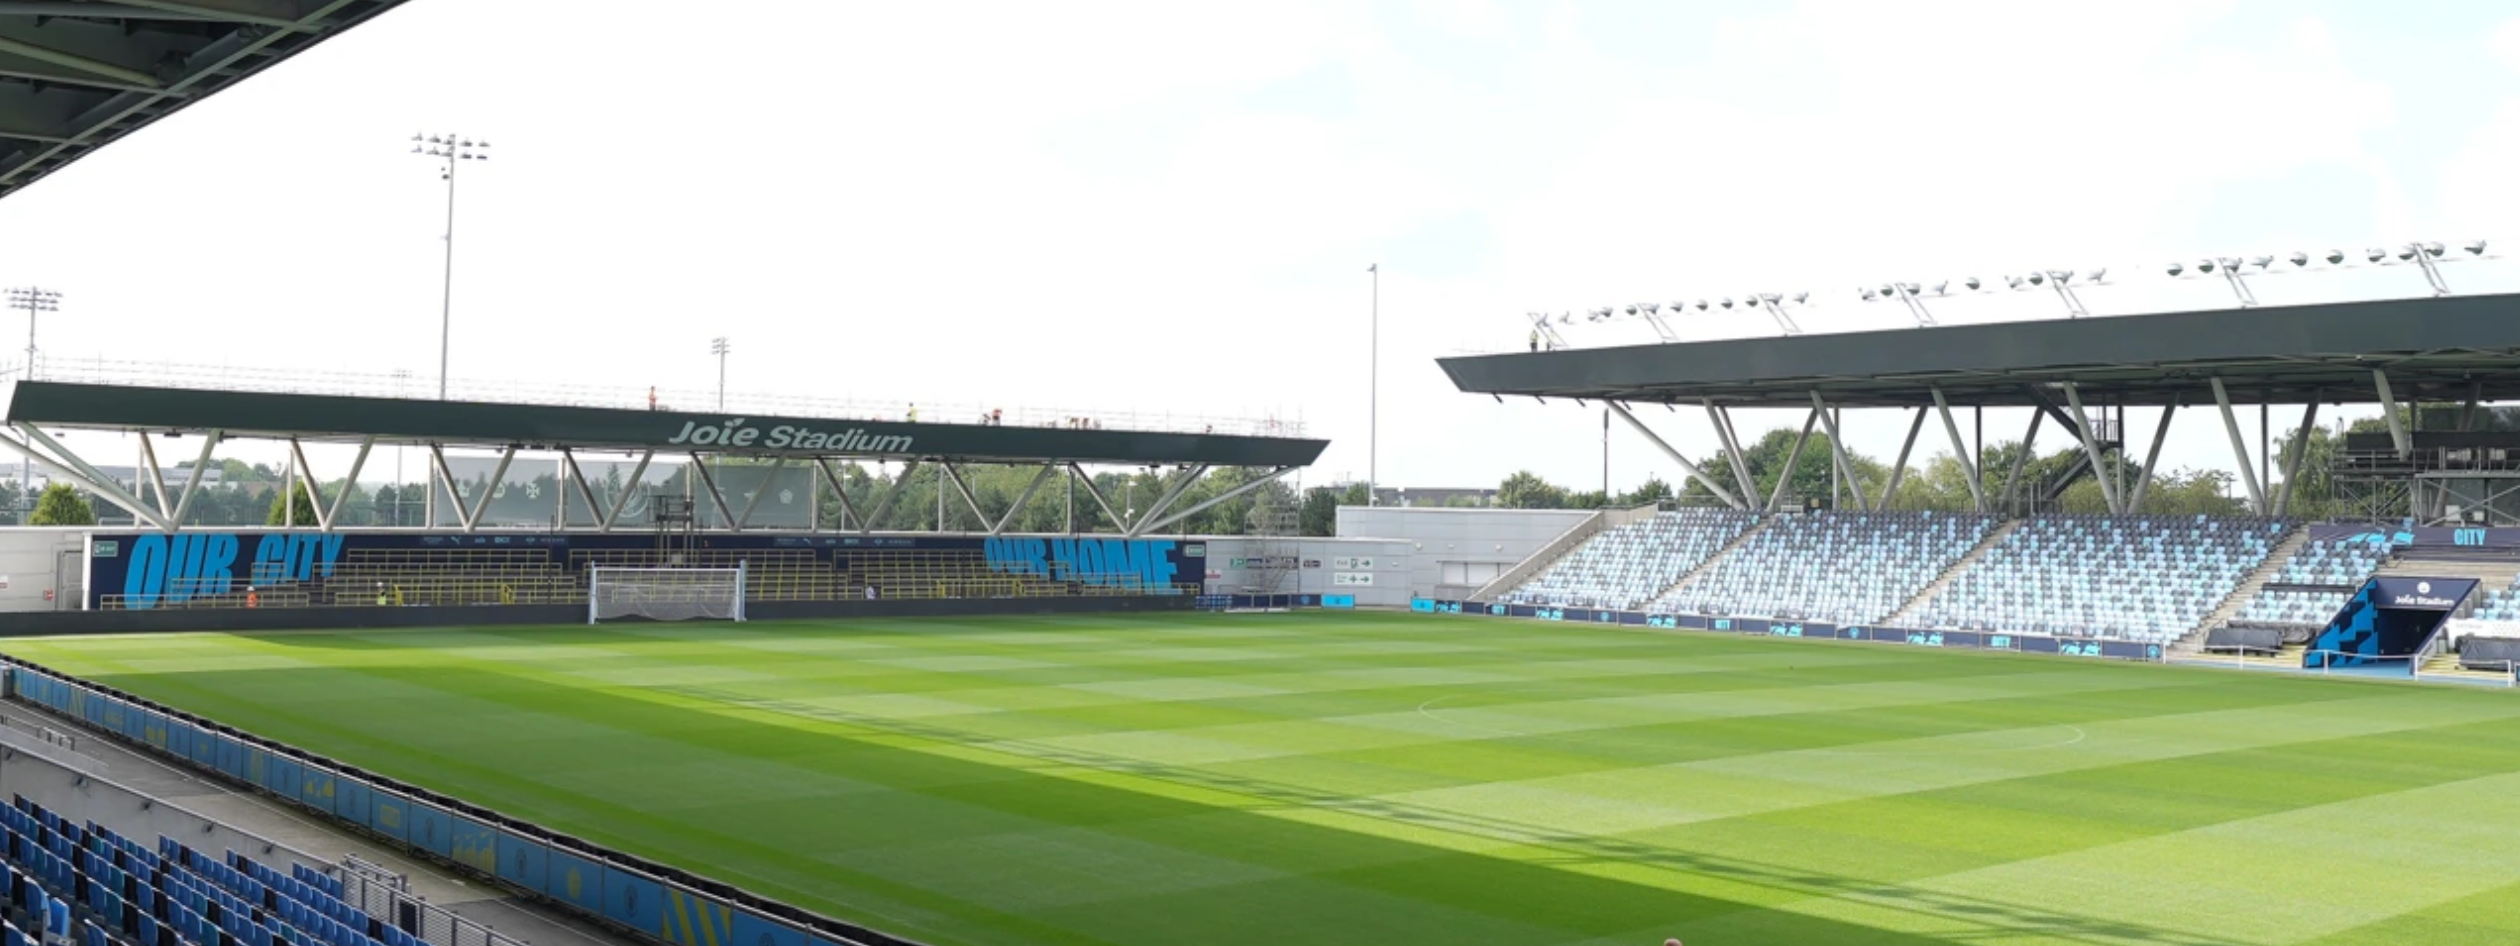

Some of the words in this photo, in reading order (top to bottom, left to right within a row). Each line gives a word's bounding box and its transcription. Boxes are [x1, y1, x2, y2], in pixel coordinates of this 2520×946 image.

[669, 418, 759, 447] Joie
[764, 425, 913, 452] Stadium
[2454, 528, 2486, 546] CITY
[124, 532, 239, 609] OUR
[253, 533, 345, 587] CITY
[984, 536, 1048, 579] OUR
[1052, 538, 1182, 595] HOME
